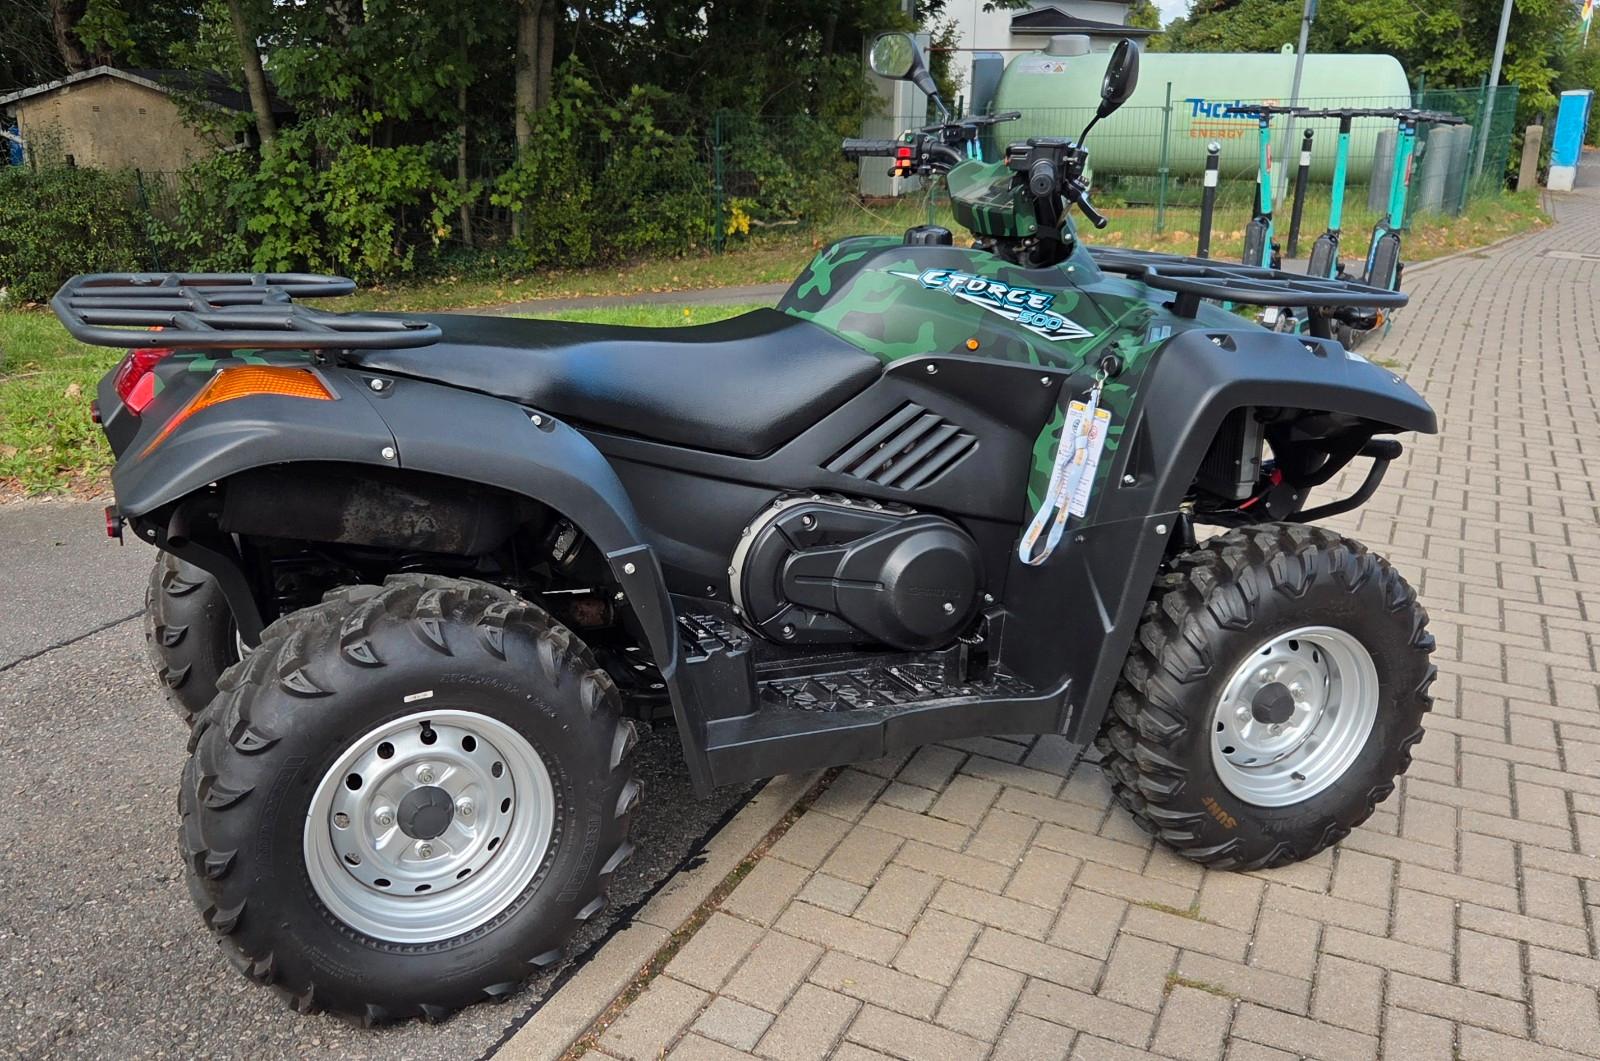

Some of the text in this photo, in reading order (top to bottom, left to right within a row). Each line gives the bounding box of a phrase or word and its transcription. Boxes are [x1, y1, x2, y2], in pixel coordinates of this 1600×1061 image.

[1191, 129, 1244, 139] ENERGY
[921, 270, 1052, 310] CFORCE
[1018, 310, 1064, 331] 500
